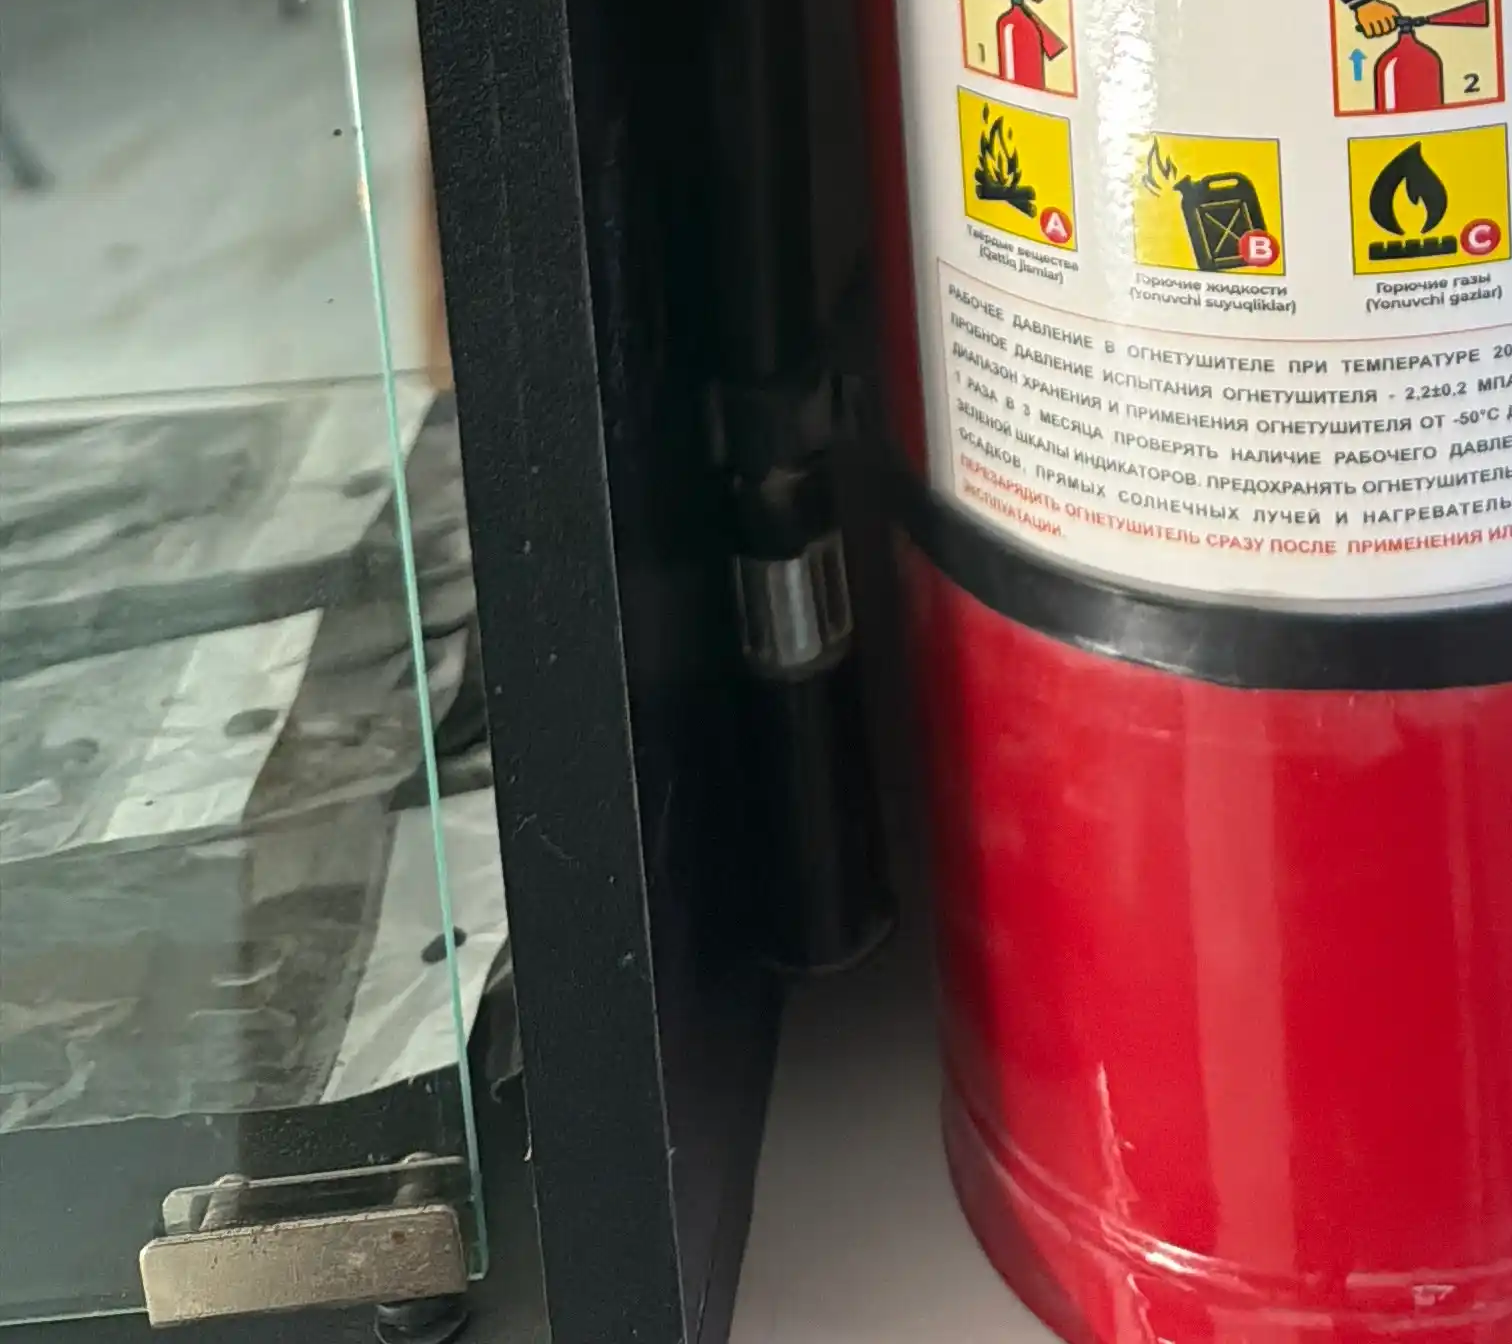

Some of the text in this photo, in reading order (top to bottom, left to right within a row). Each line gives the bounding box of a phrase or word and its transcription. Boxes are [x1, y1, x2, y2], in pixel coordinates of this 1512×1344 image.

[1463, 73, 1481, 94] 2
[1250, 237, 1273, 260] B
[1453, 273, 1491, 288] газы
[948, 283, 1004, 321] РАБОЧЕЕ
[1013, 314, 1093, 349] ДАВЛЕНИЕ
[1128, 344, 1274, 373] ОГНЕТУШИТЕЛЕ
[1289, 359, 1327, 374] ПРИ
[1342, 348, 1480, 374] ТЕМПЕРАТУРЕ
[960, 452, 1060, 512] ПЕРЕЗАРЯДИТЬ
[1065, 503, 1200, 545] ОГНЕТУШИТЕЛЬ
[1206, 534, 1264, 552] СРАЗУ
[1271, 539, 1336, 555] ПОСЛЕ
[1348, 530, 1482, 554] ПРИМЕНЕНИЯ
